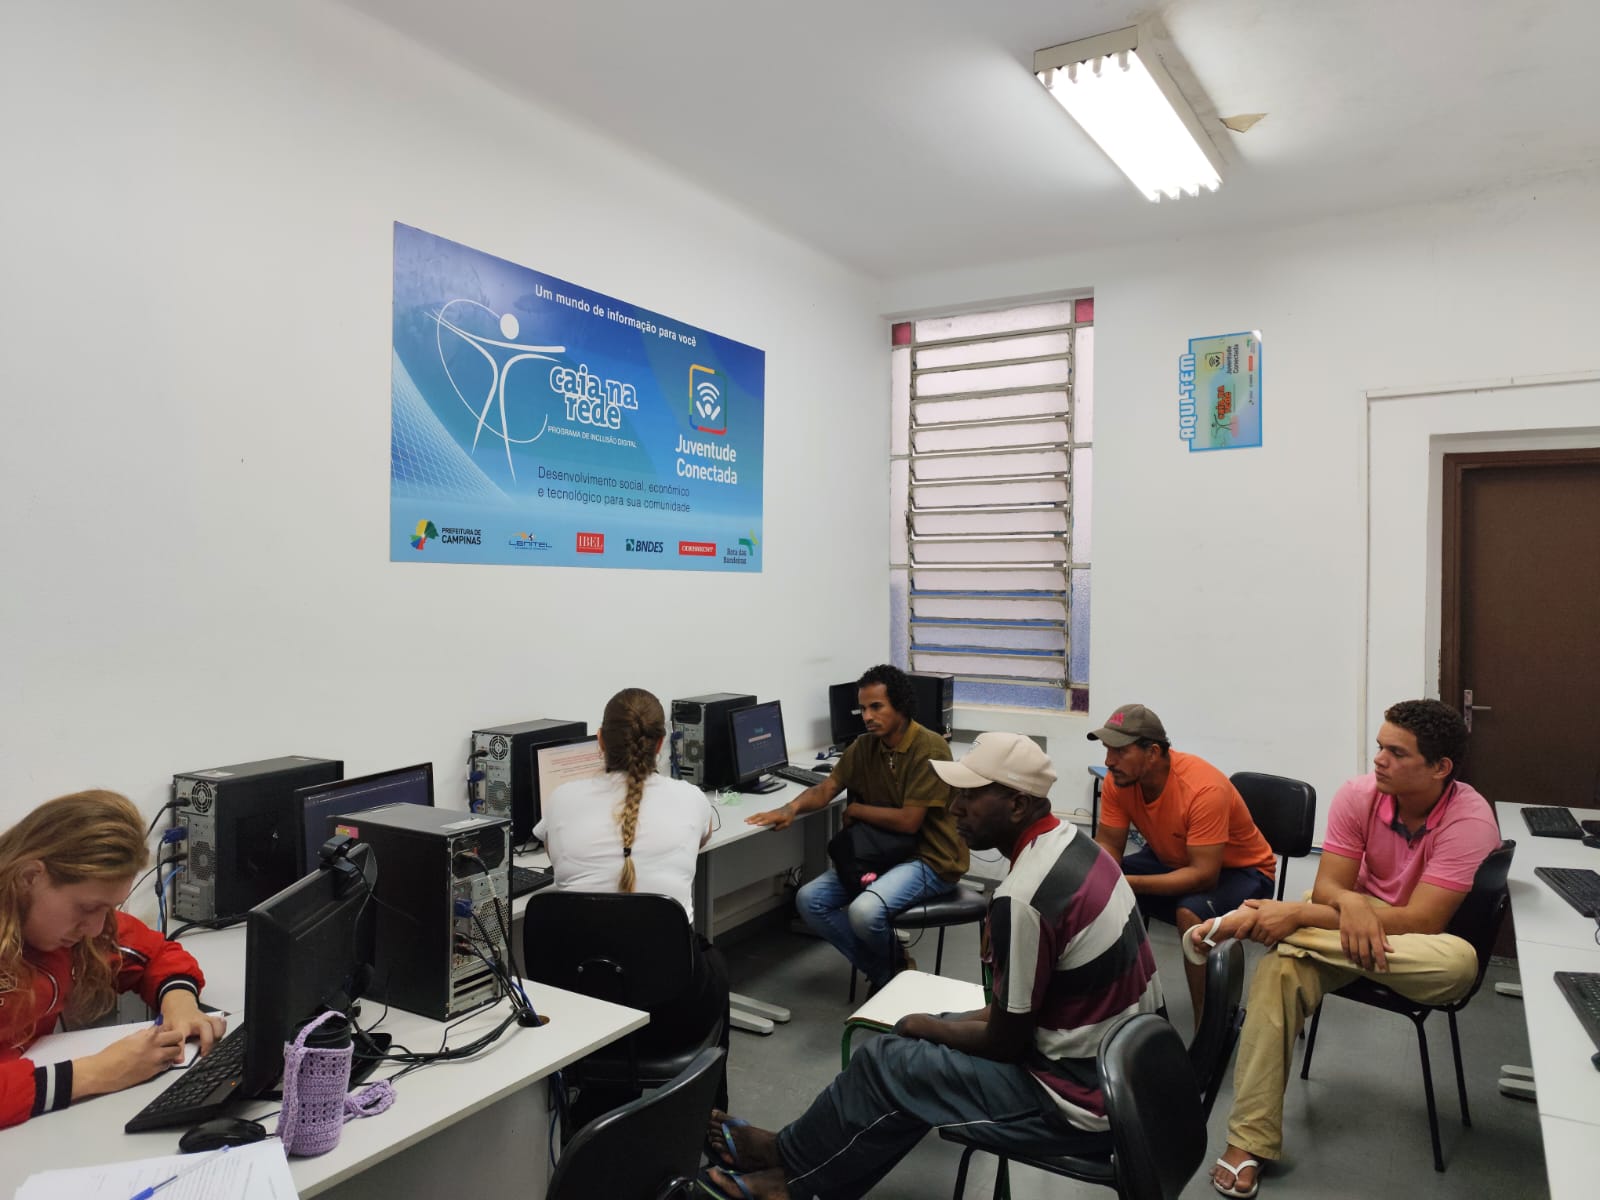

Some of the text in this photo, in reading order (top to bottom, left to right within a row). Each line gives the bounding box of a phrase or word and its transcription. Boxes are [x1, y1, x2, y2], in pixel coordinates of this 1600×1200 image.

[535, 284, 697, 348] Um mundo de informação para você
[550, 364, 639, 410] caia na
[1180, 354, 1197, 440] AQUI TEM
[565, 393, 621, 430] rede
[547, 425, 638, 448] PROGRAMA DE INCLUSÃO DIGITAL
[675, 434, 737, 462] Juventude
[538, 466, 690, 497] Desenvolvimento social, econômico
[676, 458, 738, 485] Conectada
[537, 487, 691, 513] e tecnológico para sua comunidade
[442, 528, 474, 536] PREFEITURA
[442, 535, 482, 545] CAMPINAS
[636, 540, 664, 553] BNDES
